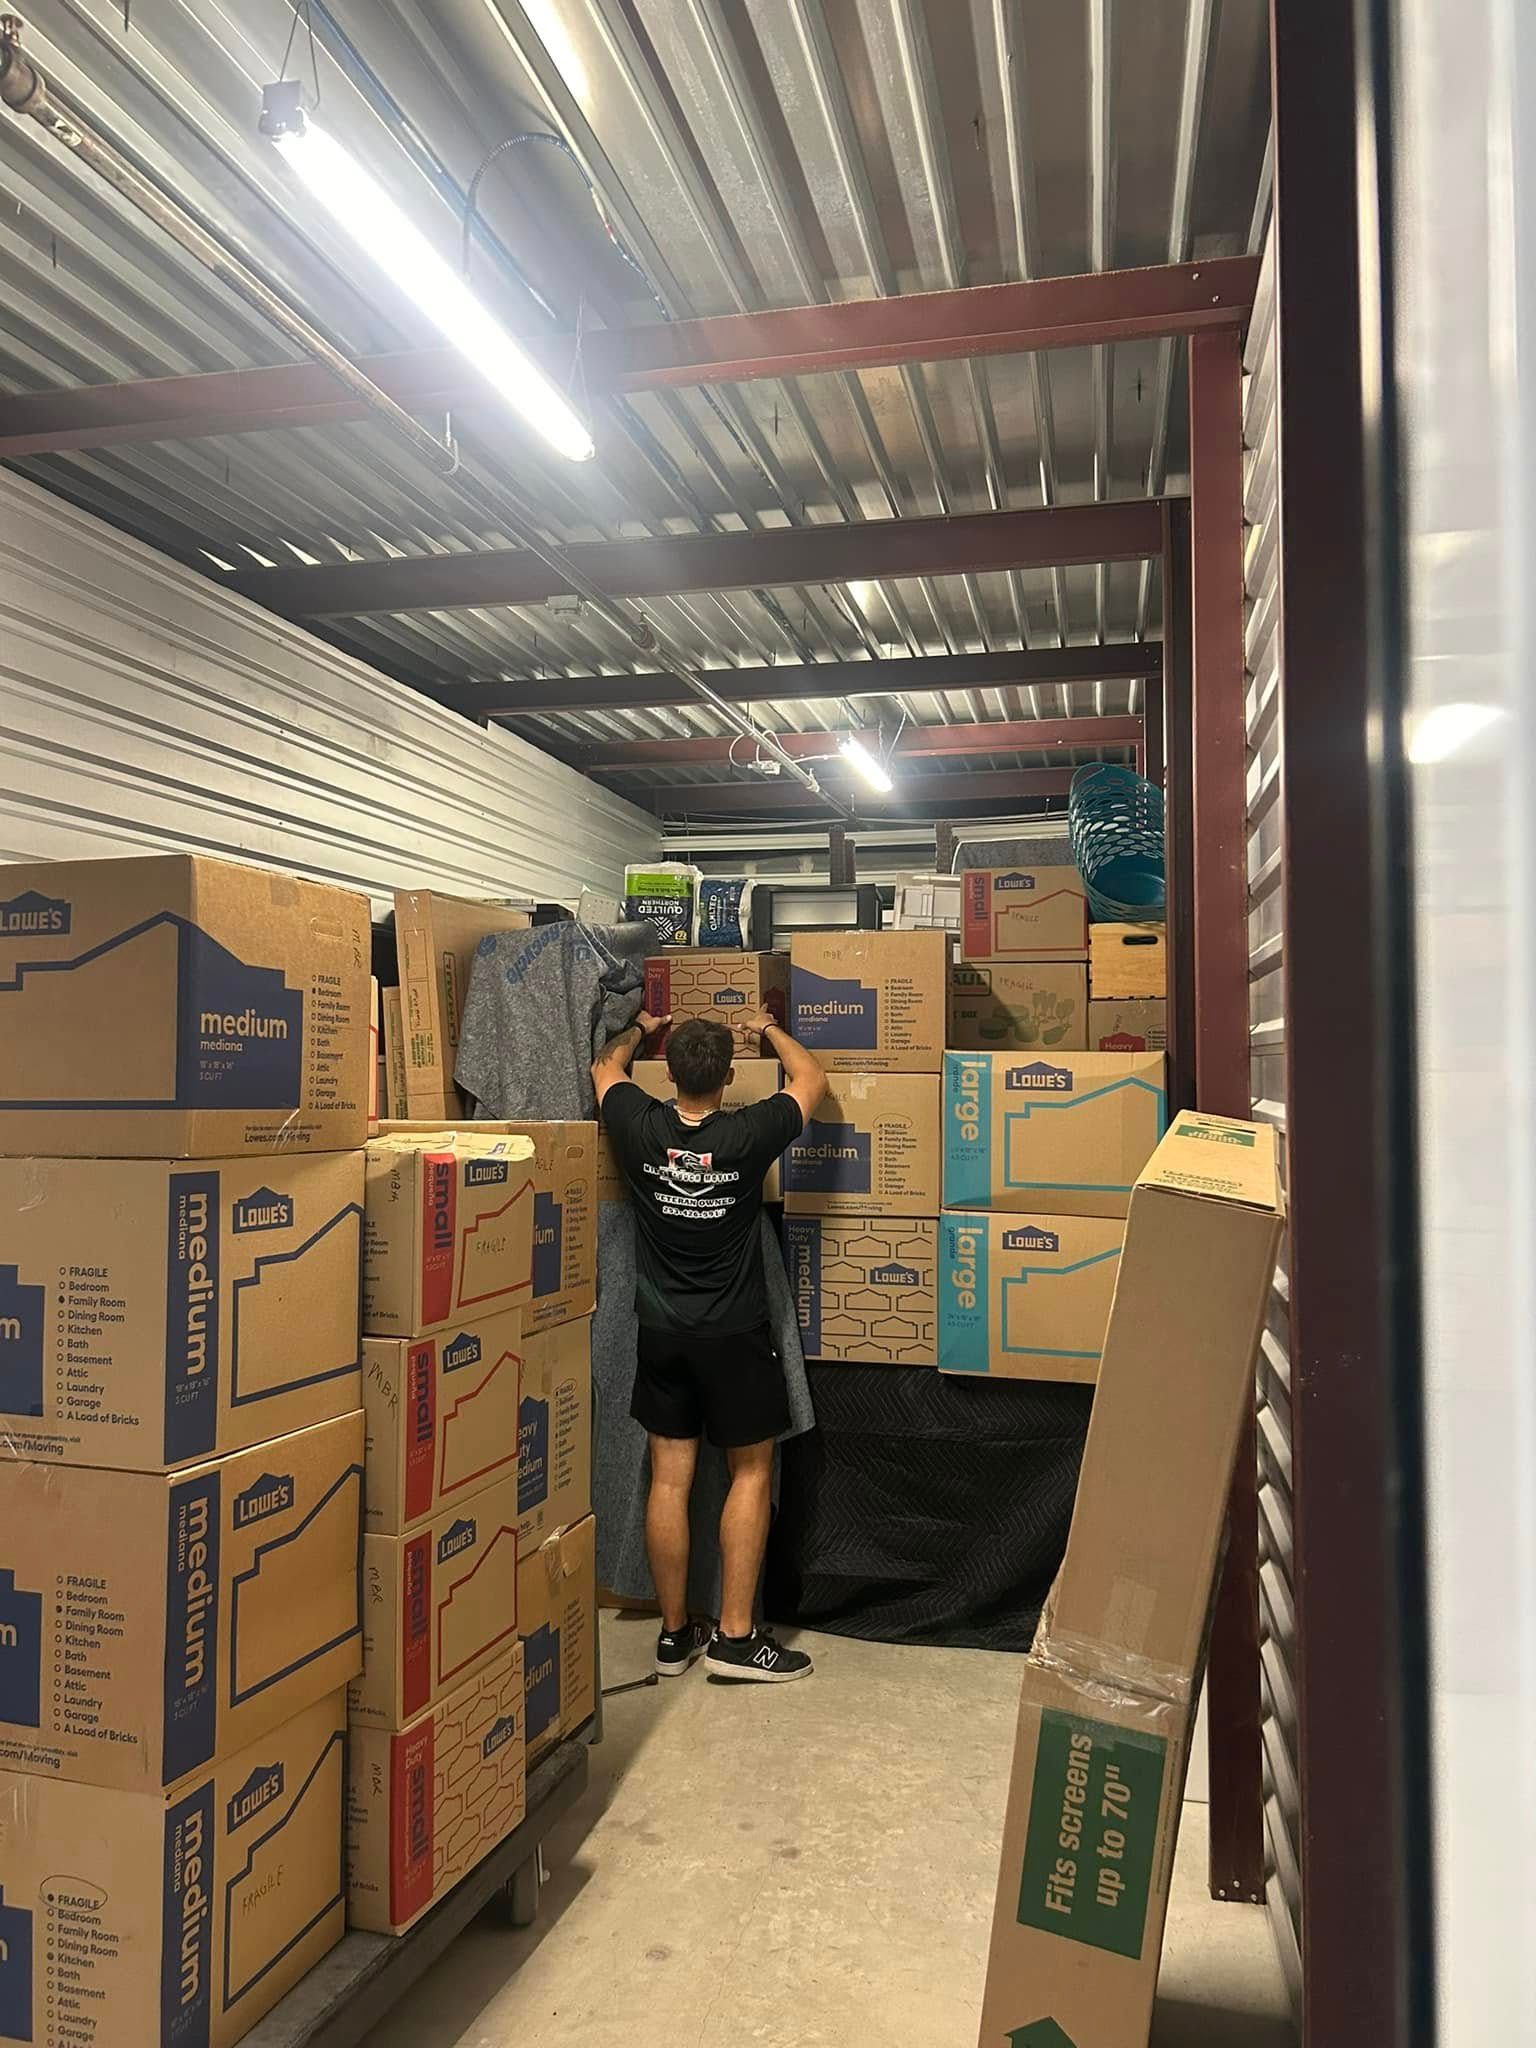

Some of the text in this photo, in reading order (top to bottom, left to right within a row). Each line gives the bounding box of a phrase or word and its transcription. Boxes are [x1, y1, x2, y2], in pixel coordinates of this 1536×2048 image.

[998, 879, 1031, 889] LOWE'S
[973, 877, 988, 920] small
[638, 905, 683, 915] QUILTED
[0, 908, 63, 931] LOWE'S
[318, 974, 341, 986] FRAGILE
[318, 988, 342, 998] Bedroom
[716, 993, 743, 1004] LOWE'S
[318, 1001, 335, 1011] Family
[798, 1000, 864, 1015] medium
[200, 1009, 288, 1039] medium
[317, 1014, 350, 1024] Dining Room
[317, 1026, 338, 1035] Kitchen
[200, 1039, 243, 1052] mediana
[317, 1038, 330, 1047] Bath
[1105, 1042, 1134, 1050] Heavy
[317, 1051, 343, 1061] Basement
[316, 1063, 330, 1072] Attic
[316, 1076, 338, 1085] Laundry
[1012, 1072, 1066, 1088] LOWE'S
[316, 1089, 337, 1099] Garage
[954, 1061, 987, 1141] large
[341, 1102, 356, 1110] Bricks
[792, 1144, 859, 1160] medium
[469, 1163, 505, 1183] LOWE'S
[432, 1162, 453, 1249] small
[653, 1192, 736, 1208] VETERAN OWNED
[239, 1201, 289, 1228] LOWE'S
[178, 1196, 187, 1260] mediana
[535, 1225, 555, 1246] ium
[788, 1225, 815, 1234] Heavy
[788, 1233, 808, 1242] Duty
[1008, 1234, 1054, 1249] LOWE'S
[69, 1267, 108, 1278] FRAGILE
[951, 1227, 983, 1310] large
[187, 1193, 214, 1375] medium
[874, 1271, 914, 1284] LOWE'S
[69, 1282, 110, 1293] Bedroom
[799, 1246, 815, 1328] medium
[68, 1296, 126, 1308] Family Room
[68, 1310, 125, 1323] Dining Room
[67, 1325, 103, 1336] Kitchen
[67, 1339, 89, 1349] Bath
[67, 1354, 113, 1366] Basement
[447, 1343, 478, 1368] LOWE'S
[67, 1367, 89, 1378] Attic
[67, 1383, 105, 1396] Laundry
[416, 1351, 433, 1443] small
[67, 1397, 102, 1410] Garage
[67, 1411, 139, 1426] A Load of Bricks
[518, 1421, 538, 1440] eavy
[518, 1456, 543, 1479] edium
[240, 1484, 289, 1521] LOWE'S
[178, 1506, 187, 1572] mediana
[441, 1528, 473, 1558] LOWE'S
[66, 1576, 107, 1589] FRAGILE
[66, 1591, 108, 1605] Bedroom
[184, 1496, 214, 1688] medium
[66, 1606, 125, 1622] Family Room
[65, 1621, 124, 1637] Dining Room
[65, 1635, 101, 1649] Kitchen
[64, 1650, 87, 1662] Bath
[753, 1645, 779, 1669] N
[64, 1665, 111, 1680] Basement
[525, 1658, 552, 1692] dium
[64, 1679, 87, 1692] Attic
[64, 1694, 103, 1709] Laundry
[64, 1708, 99, 1724] Garage
[64, 1724, 138, 1744] A Load of Bricks
[232, 1774, 280, 1824] LOWE'S
[1045, 1733, 1094, 1915] Fits screens
[1096, 1764, 1132, 1907] up to 70"
[173, 1824, 182, 1893] mediana
[58, 1895, 99, 1910] FRAGILE
[181, 1808, 208, 2005] medium
[58, 1909, 102, 1925] Bedroom
[58, 1924, 119, 1943] Family Room
[58, 1939, 118, 1957] Dining Room
[58, 1953, 94, 1968] Kitchen
[58, 1968, 80, 1980] Bath
[58, 1982, 106, 1999] Basement
[57, 1997, 80, 2009] Attic
[58, 2011, 97, 2028] Laundry
[58, 2025, 94, 2042] Garage
